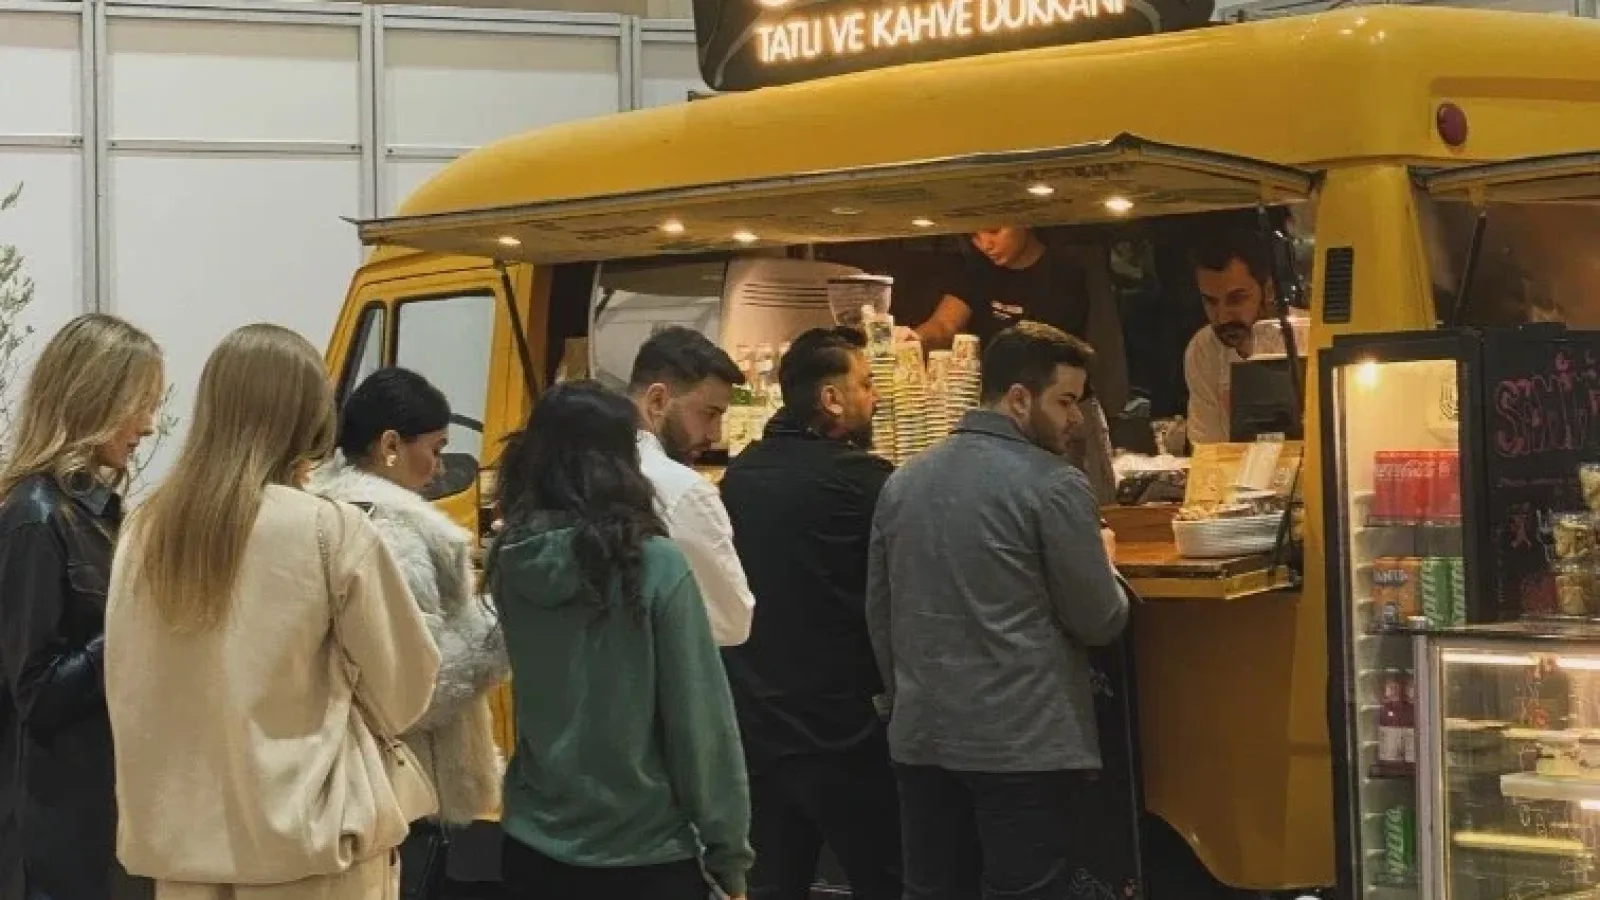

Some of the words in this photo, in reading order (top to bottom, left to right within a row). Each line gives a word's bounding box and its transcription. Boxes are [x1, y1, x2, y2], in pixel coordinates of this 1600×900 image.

[754, 18, 822, 62] TATLI
[827, 12, 865, 53] VE
[873, 0, 973, 47] KAHVE
